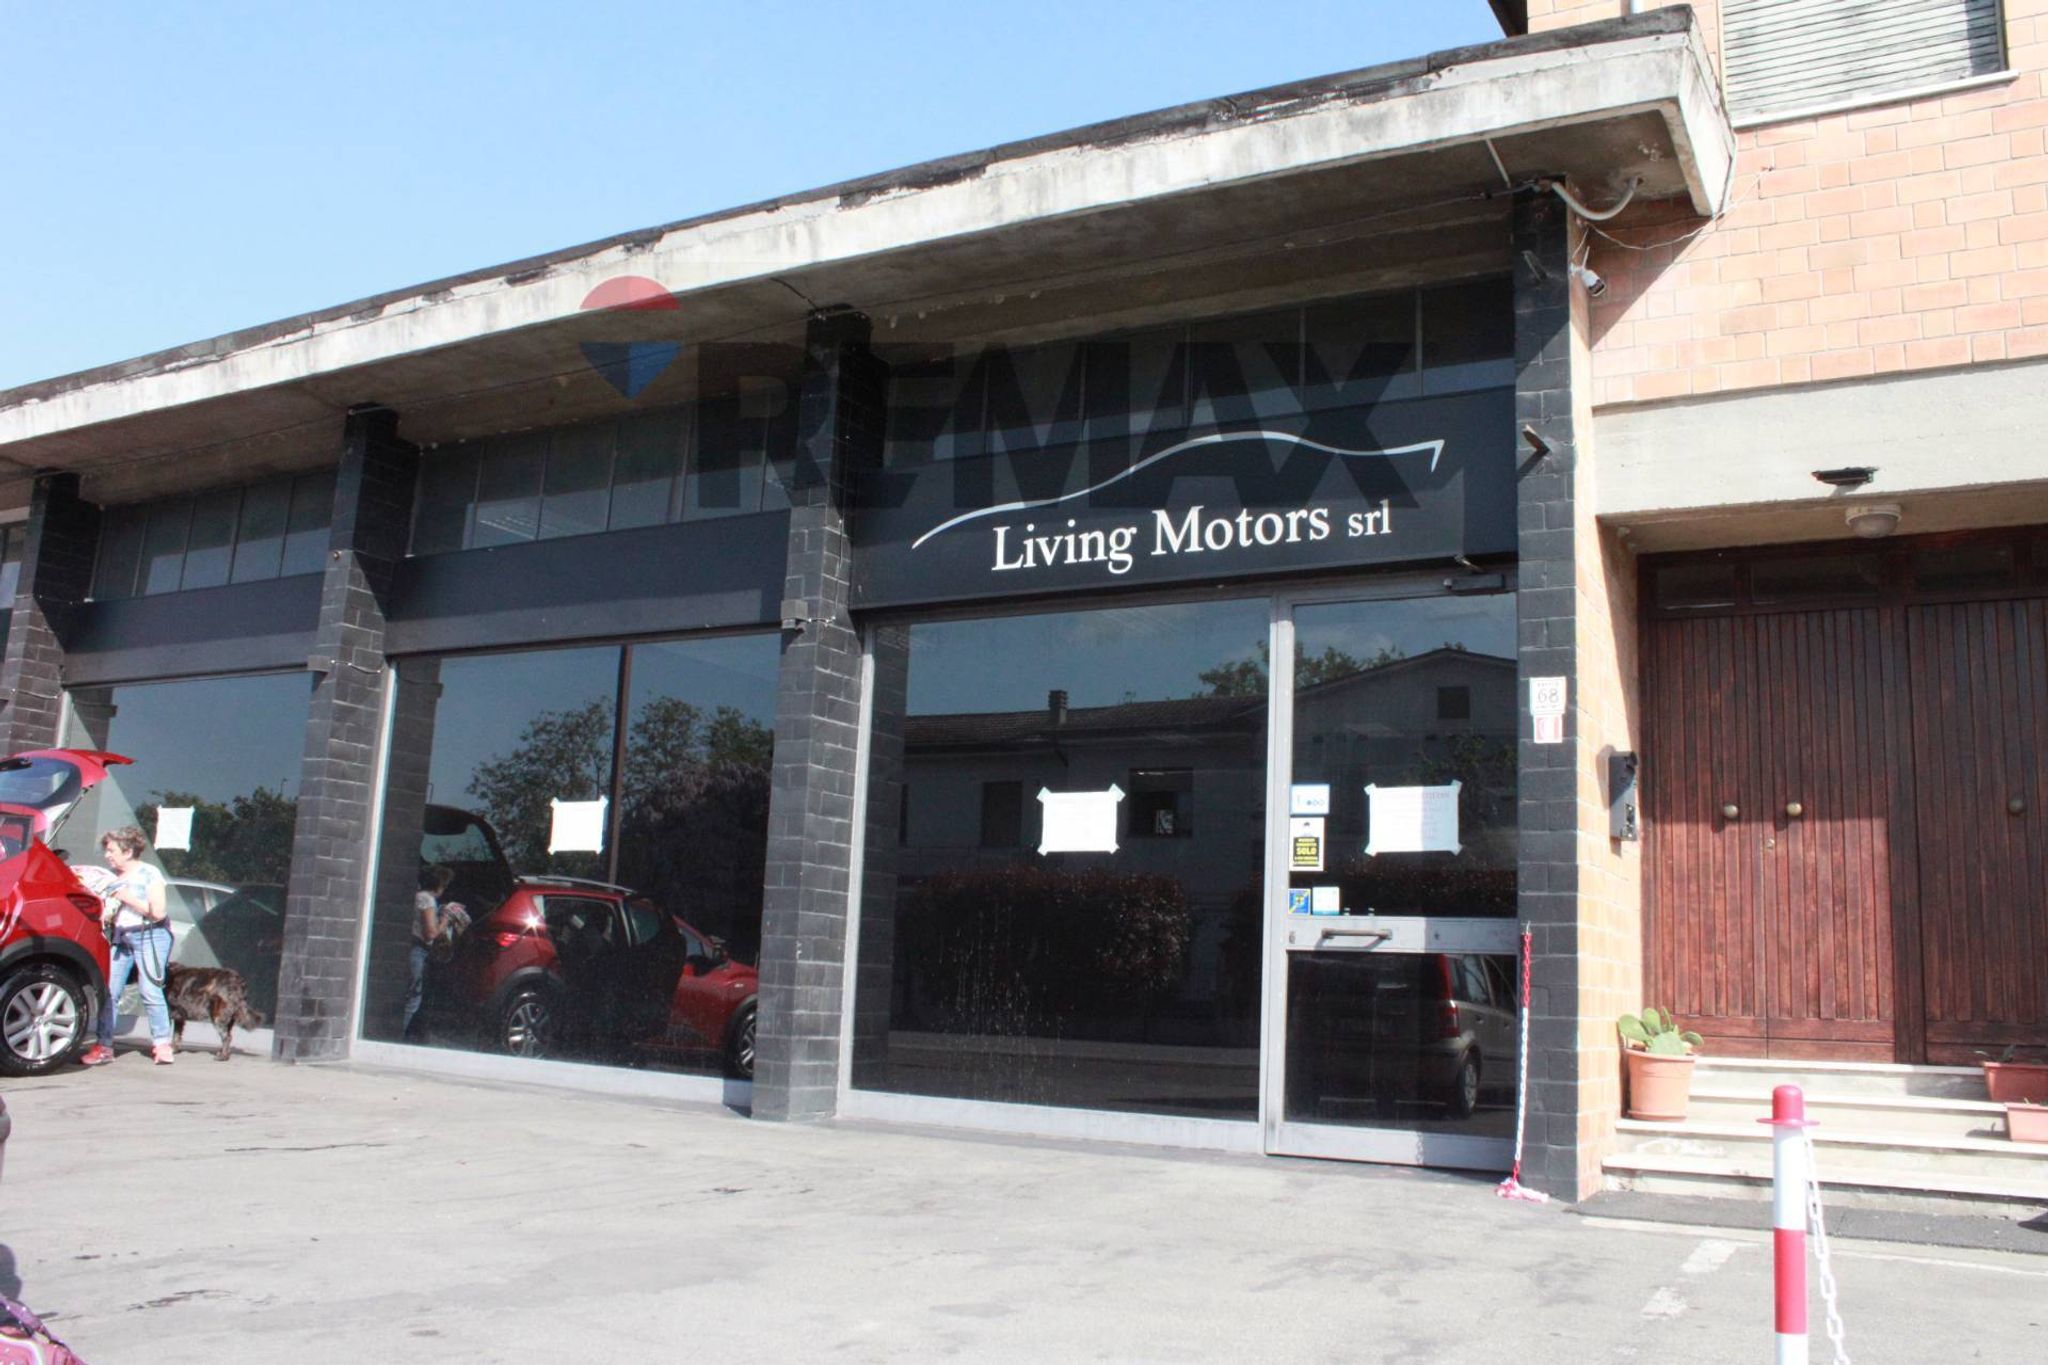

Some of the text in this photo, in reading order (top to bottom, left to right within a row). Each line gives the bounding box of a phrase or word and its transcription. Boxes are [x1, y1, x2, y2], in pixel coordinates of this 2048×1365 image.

[991, 500, 1392, 575] Living Motors srl
[1537, 687, 1560, 704] 68
